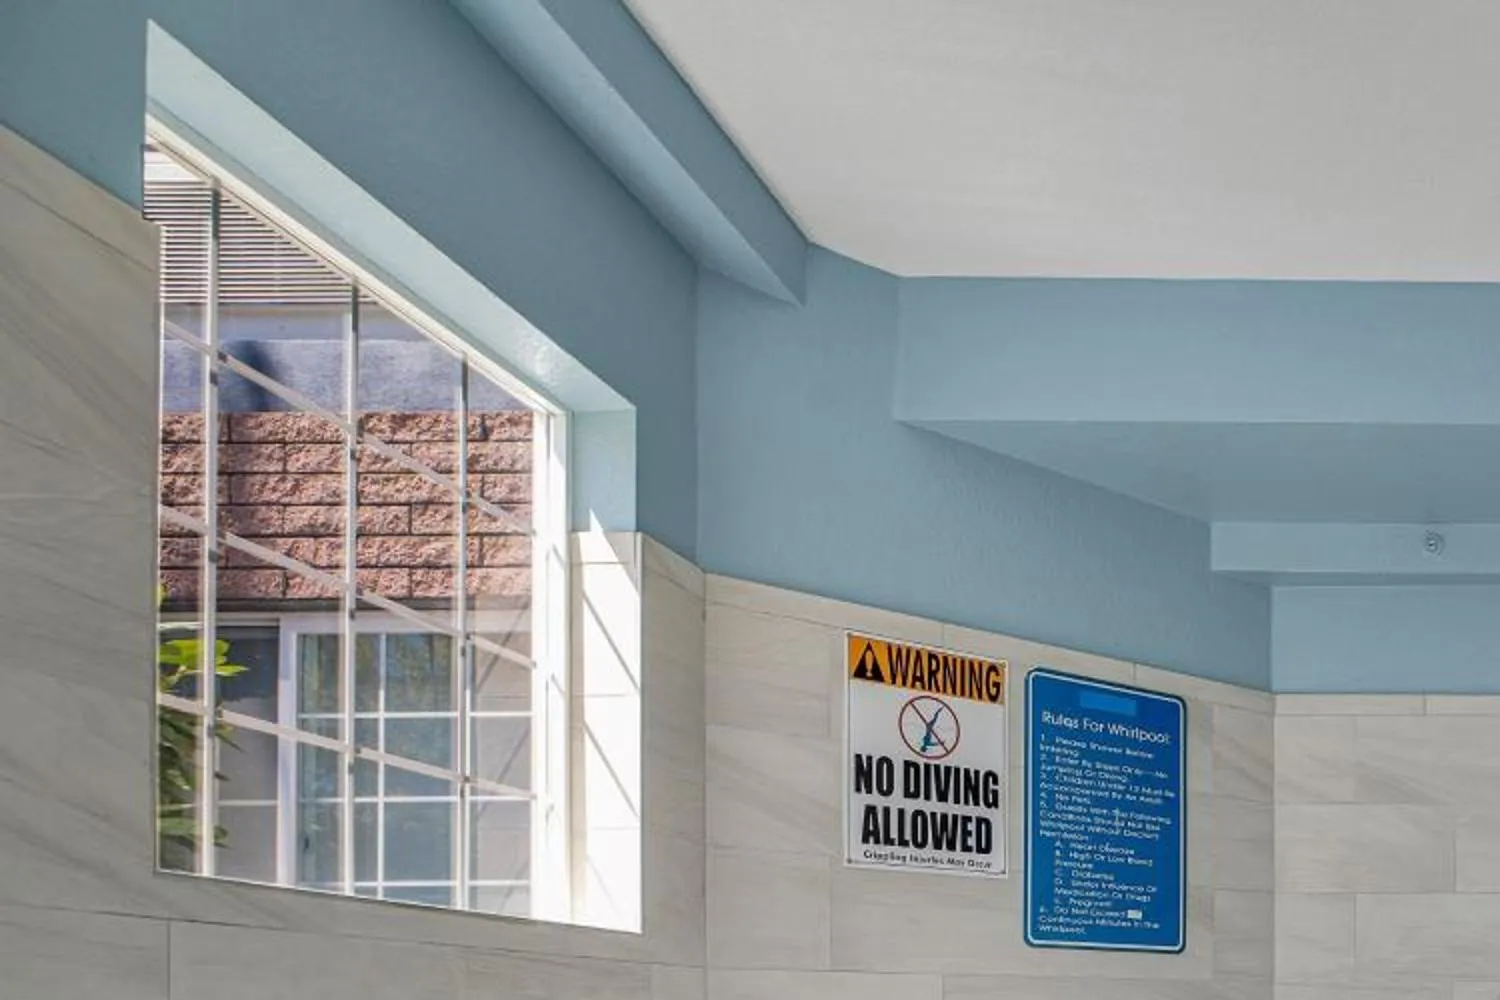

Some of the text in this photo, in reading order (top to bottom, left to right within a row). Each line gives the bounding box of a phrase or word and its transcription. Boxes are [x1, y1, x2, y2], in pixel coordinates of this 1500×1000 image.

[886, 640, 1002, 704] WARNING
[1041, 711, 1079, 729] Rules
[1083, 718, 1104, 733] For
[854, 752, 999, 809] NO DIVING
[861, 803, 993, 855] ALLOWED
